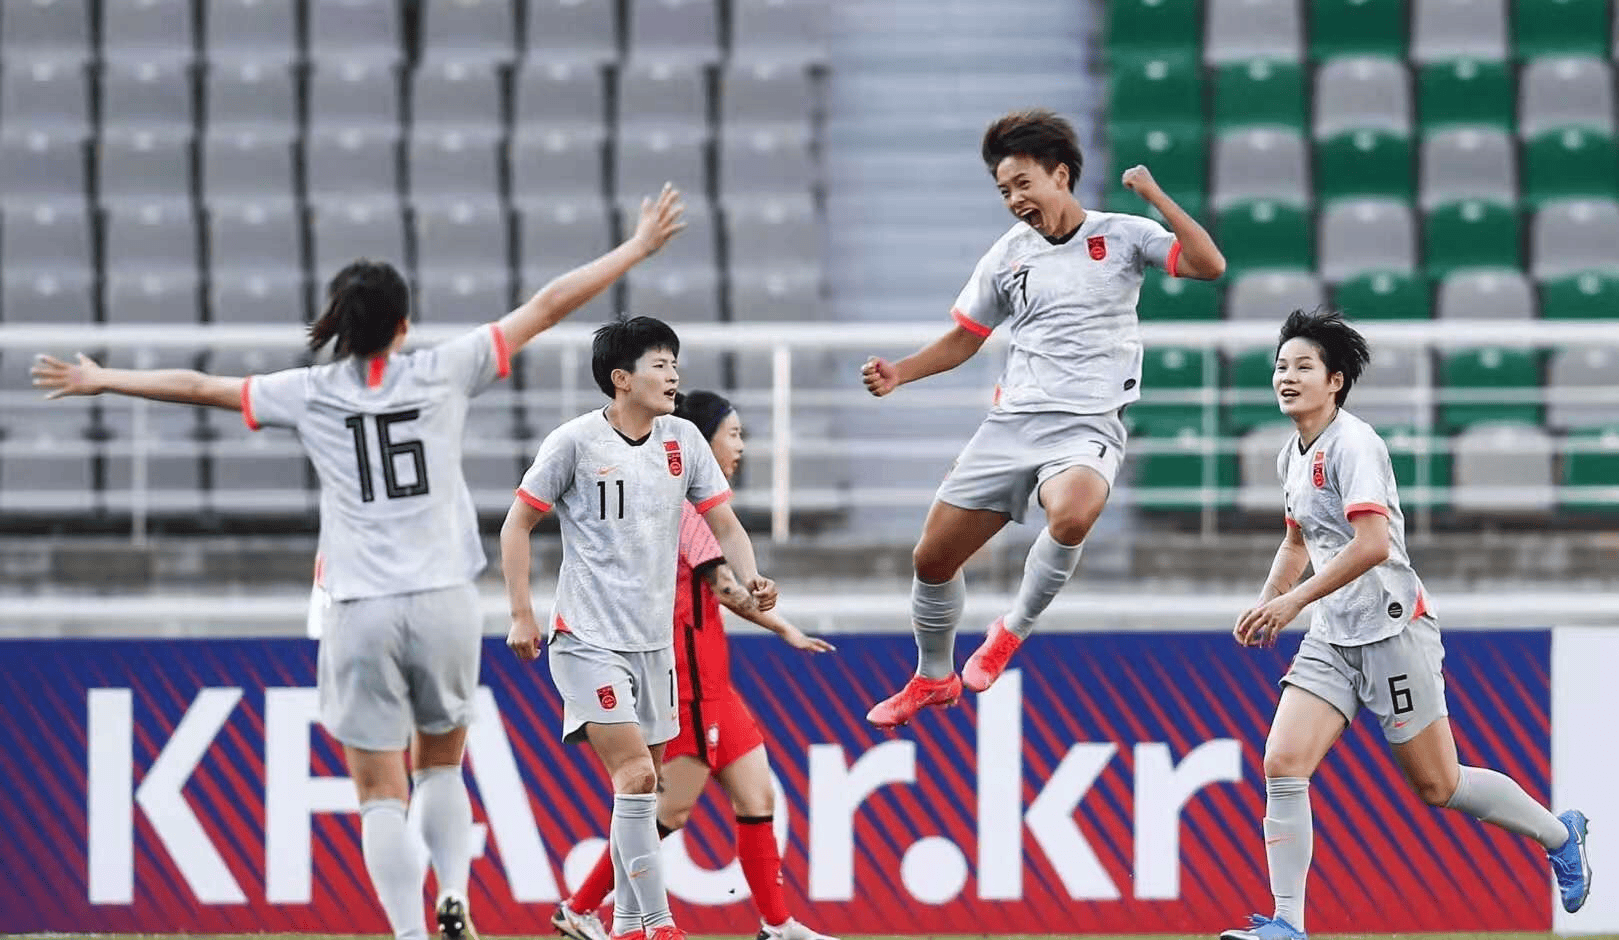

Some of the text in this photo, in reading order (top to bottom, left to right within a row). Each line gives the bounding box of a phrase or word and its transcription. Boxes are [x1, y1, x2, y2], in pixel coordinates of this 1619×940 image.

[1013, 269, 1029, 308] 7
[345, 409, 429, 503] 16
[597, 480, 624, 520] 11
[1388, 674, 1414, 715] 6
